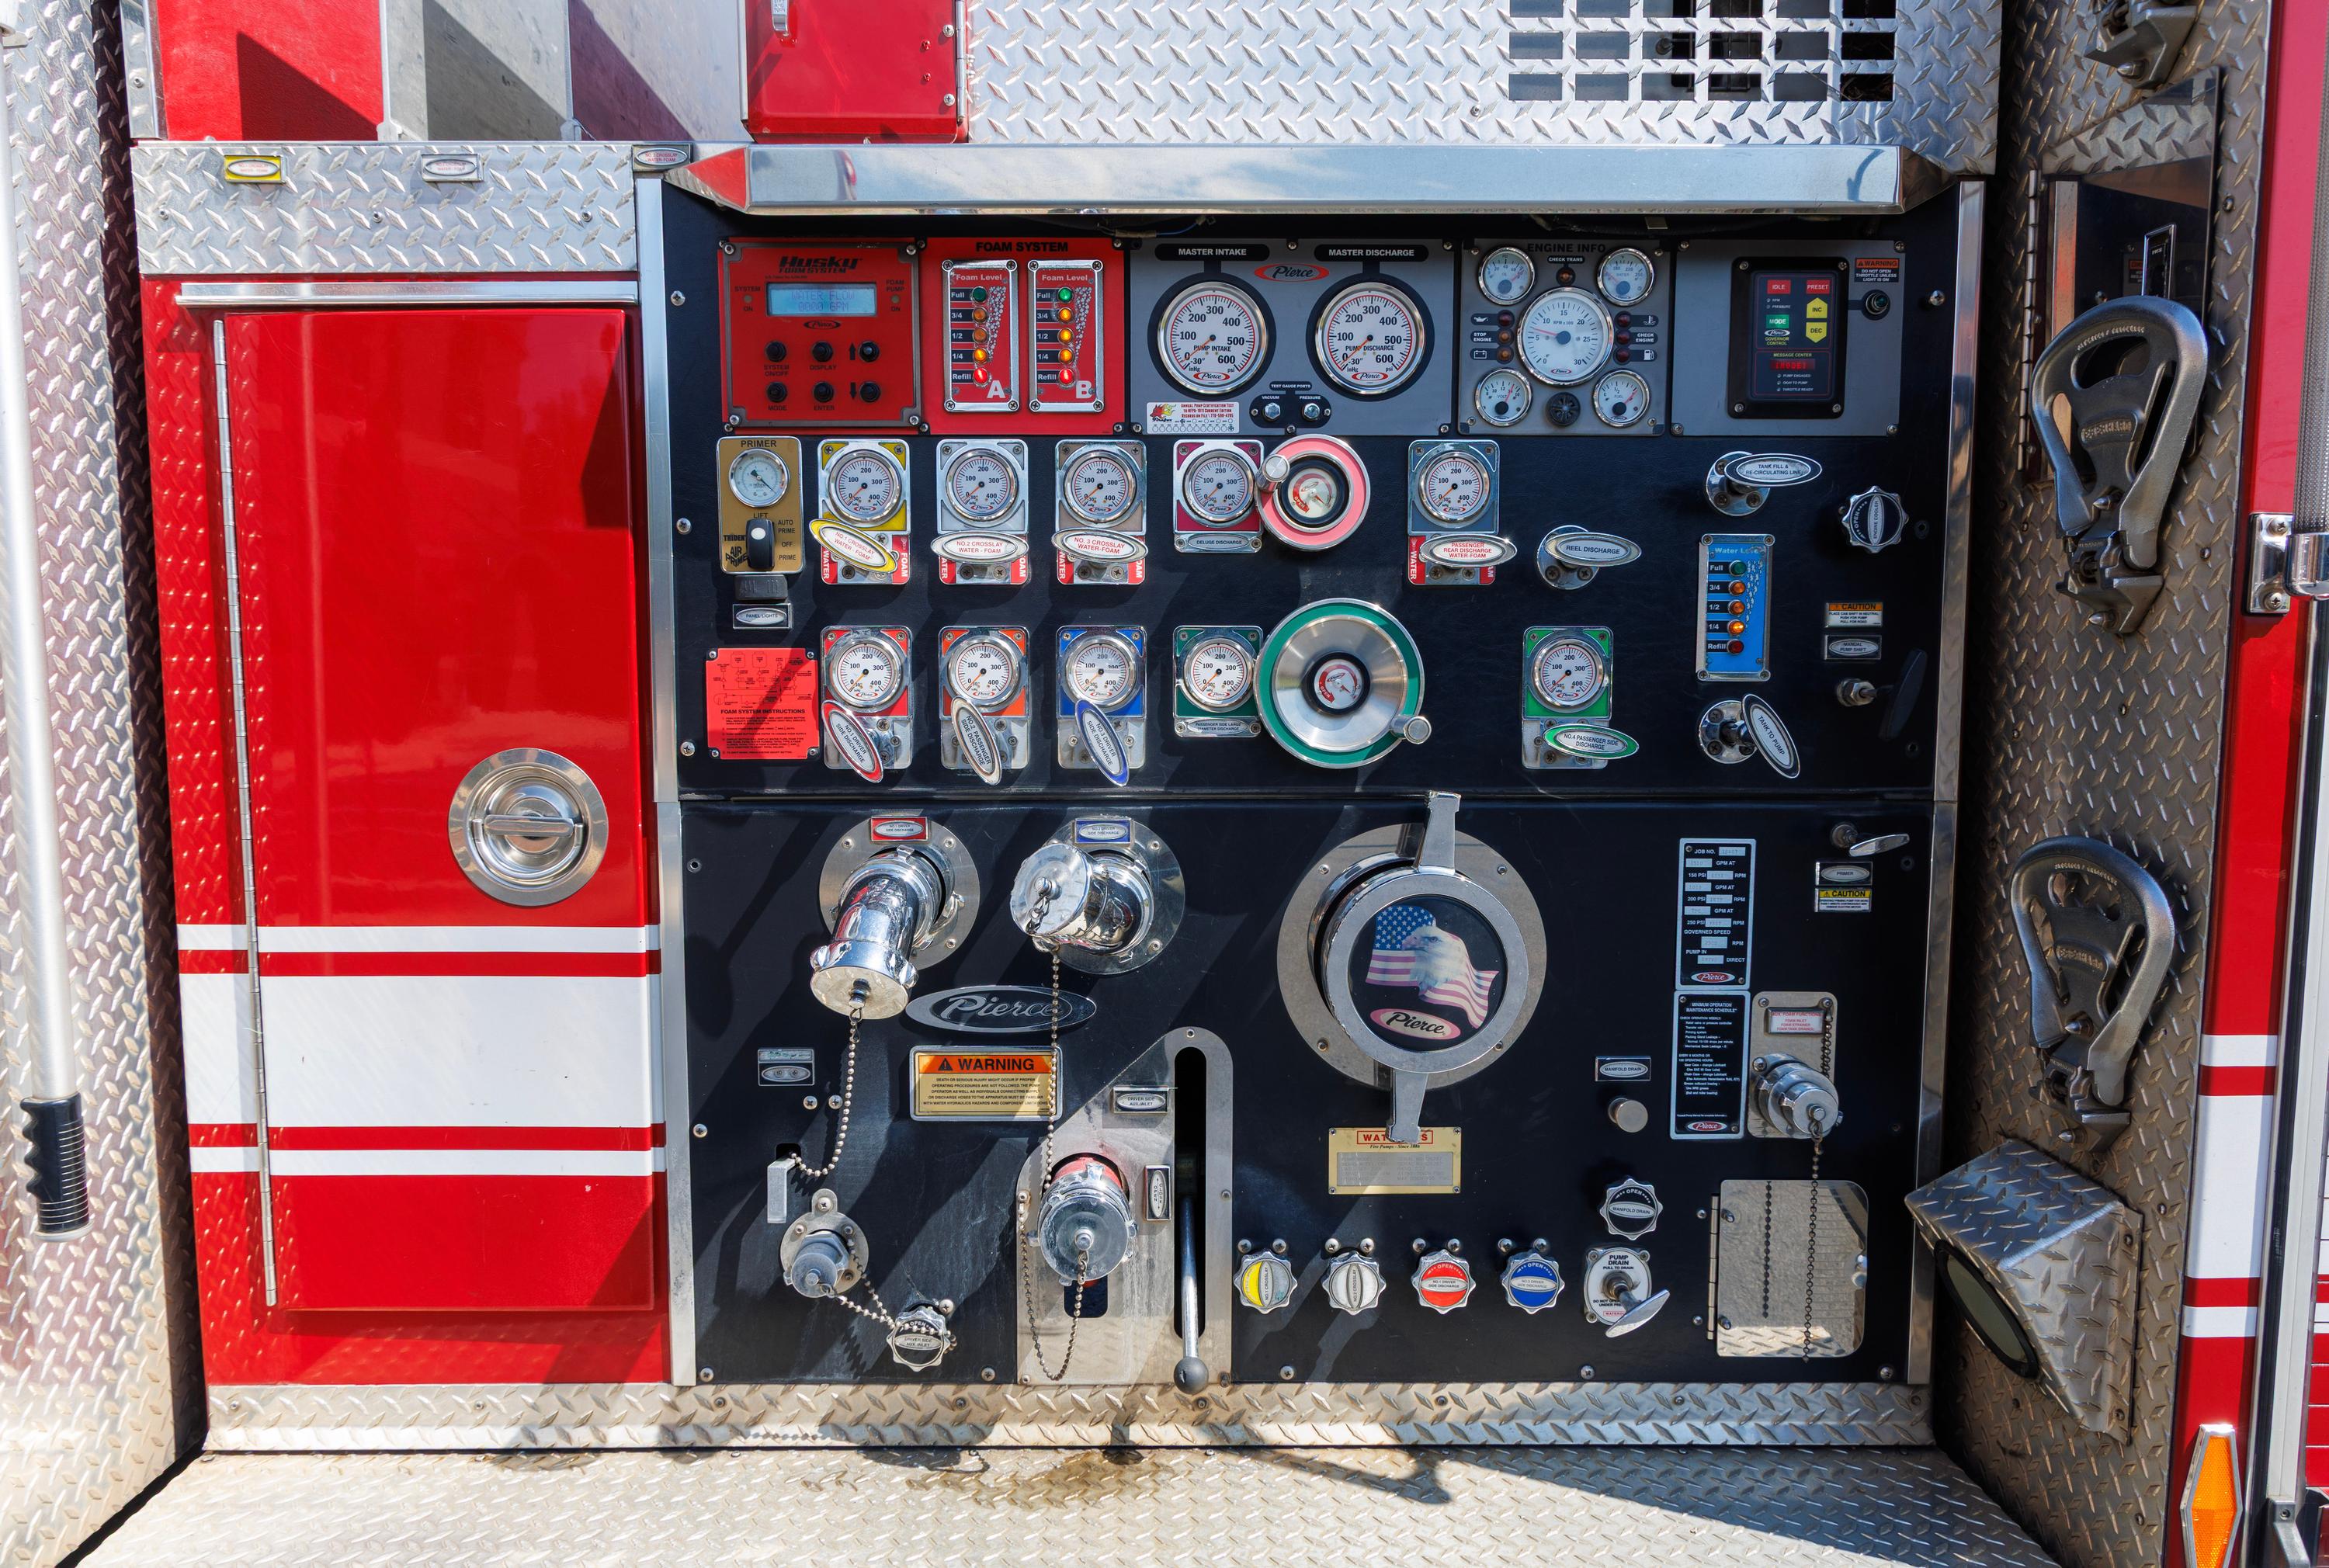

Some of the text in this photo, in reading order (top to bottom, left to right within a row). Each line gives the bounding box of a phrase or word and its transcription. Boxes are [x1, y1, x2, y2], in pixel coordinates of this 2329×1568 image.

[976, 242, 1068, 252] FOAM SYSTEM
[1528, 244, 1605, 253] ENGINE INFO
[779, 256, 859, 269] Husky
[1272, 265, 1314, 279] Pierce
[1189, 306, 1241, 327] 200 300 400
[1345, 306, 1397, 325] 200 300 400
[1180, 331, 1245, 346] 100 500
[1337, 332, 1402, 345] 100 500
[1217, 355, 1236, 364] 600
[1376, 354, 1394, 363] 600
[986, 380, 1006, 399] A
[1076, 380, 1092, 399] B
[1293, 496, 1306, 508] OPEN
[834, 538, 870, 560] WATER FOAM
[847, 536, 876, 555] CROSSLAY
[1091, 539, 1126, 549] CROSSLAY
[835, 723, 866, 764] SIDE DISCHARGE
[961, 719, 986, 765] SIDE DISCHARGE
[1086, 720, 1113, 766] SIDE DISCHARGE
[1576, 734, 1606, 744] PASSENGER
[1758, 714, 1786, 755] TANK TO PUMP
[852, 734, 867, 755] DRIVER
[973, 727, 991, 765] PASSENGER
[1102, 735, 1116, 758] DRIVER
[1576, 741, 1605, 750] DISCHARGE
[941, 995, 1061, 1020] Pierce
[1386, 1011, 1445, 1035] Pierce
[957, 1058, 1034, 1070] WARNING
